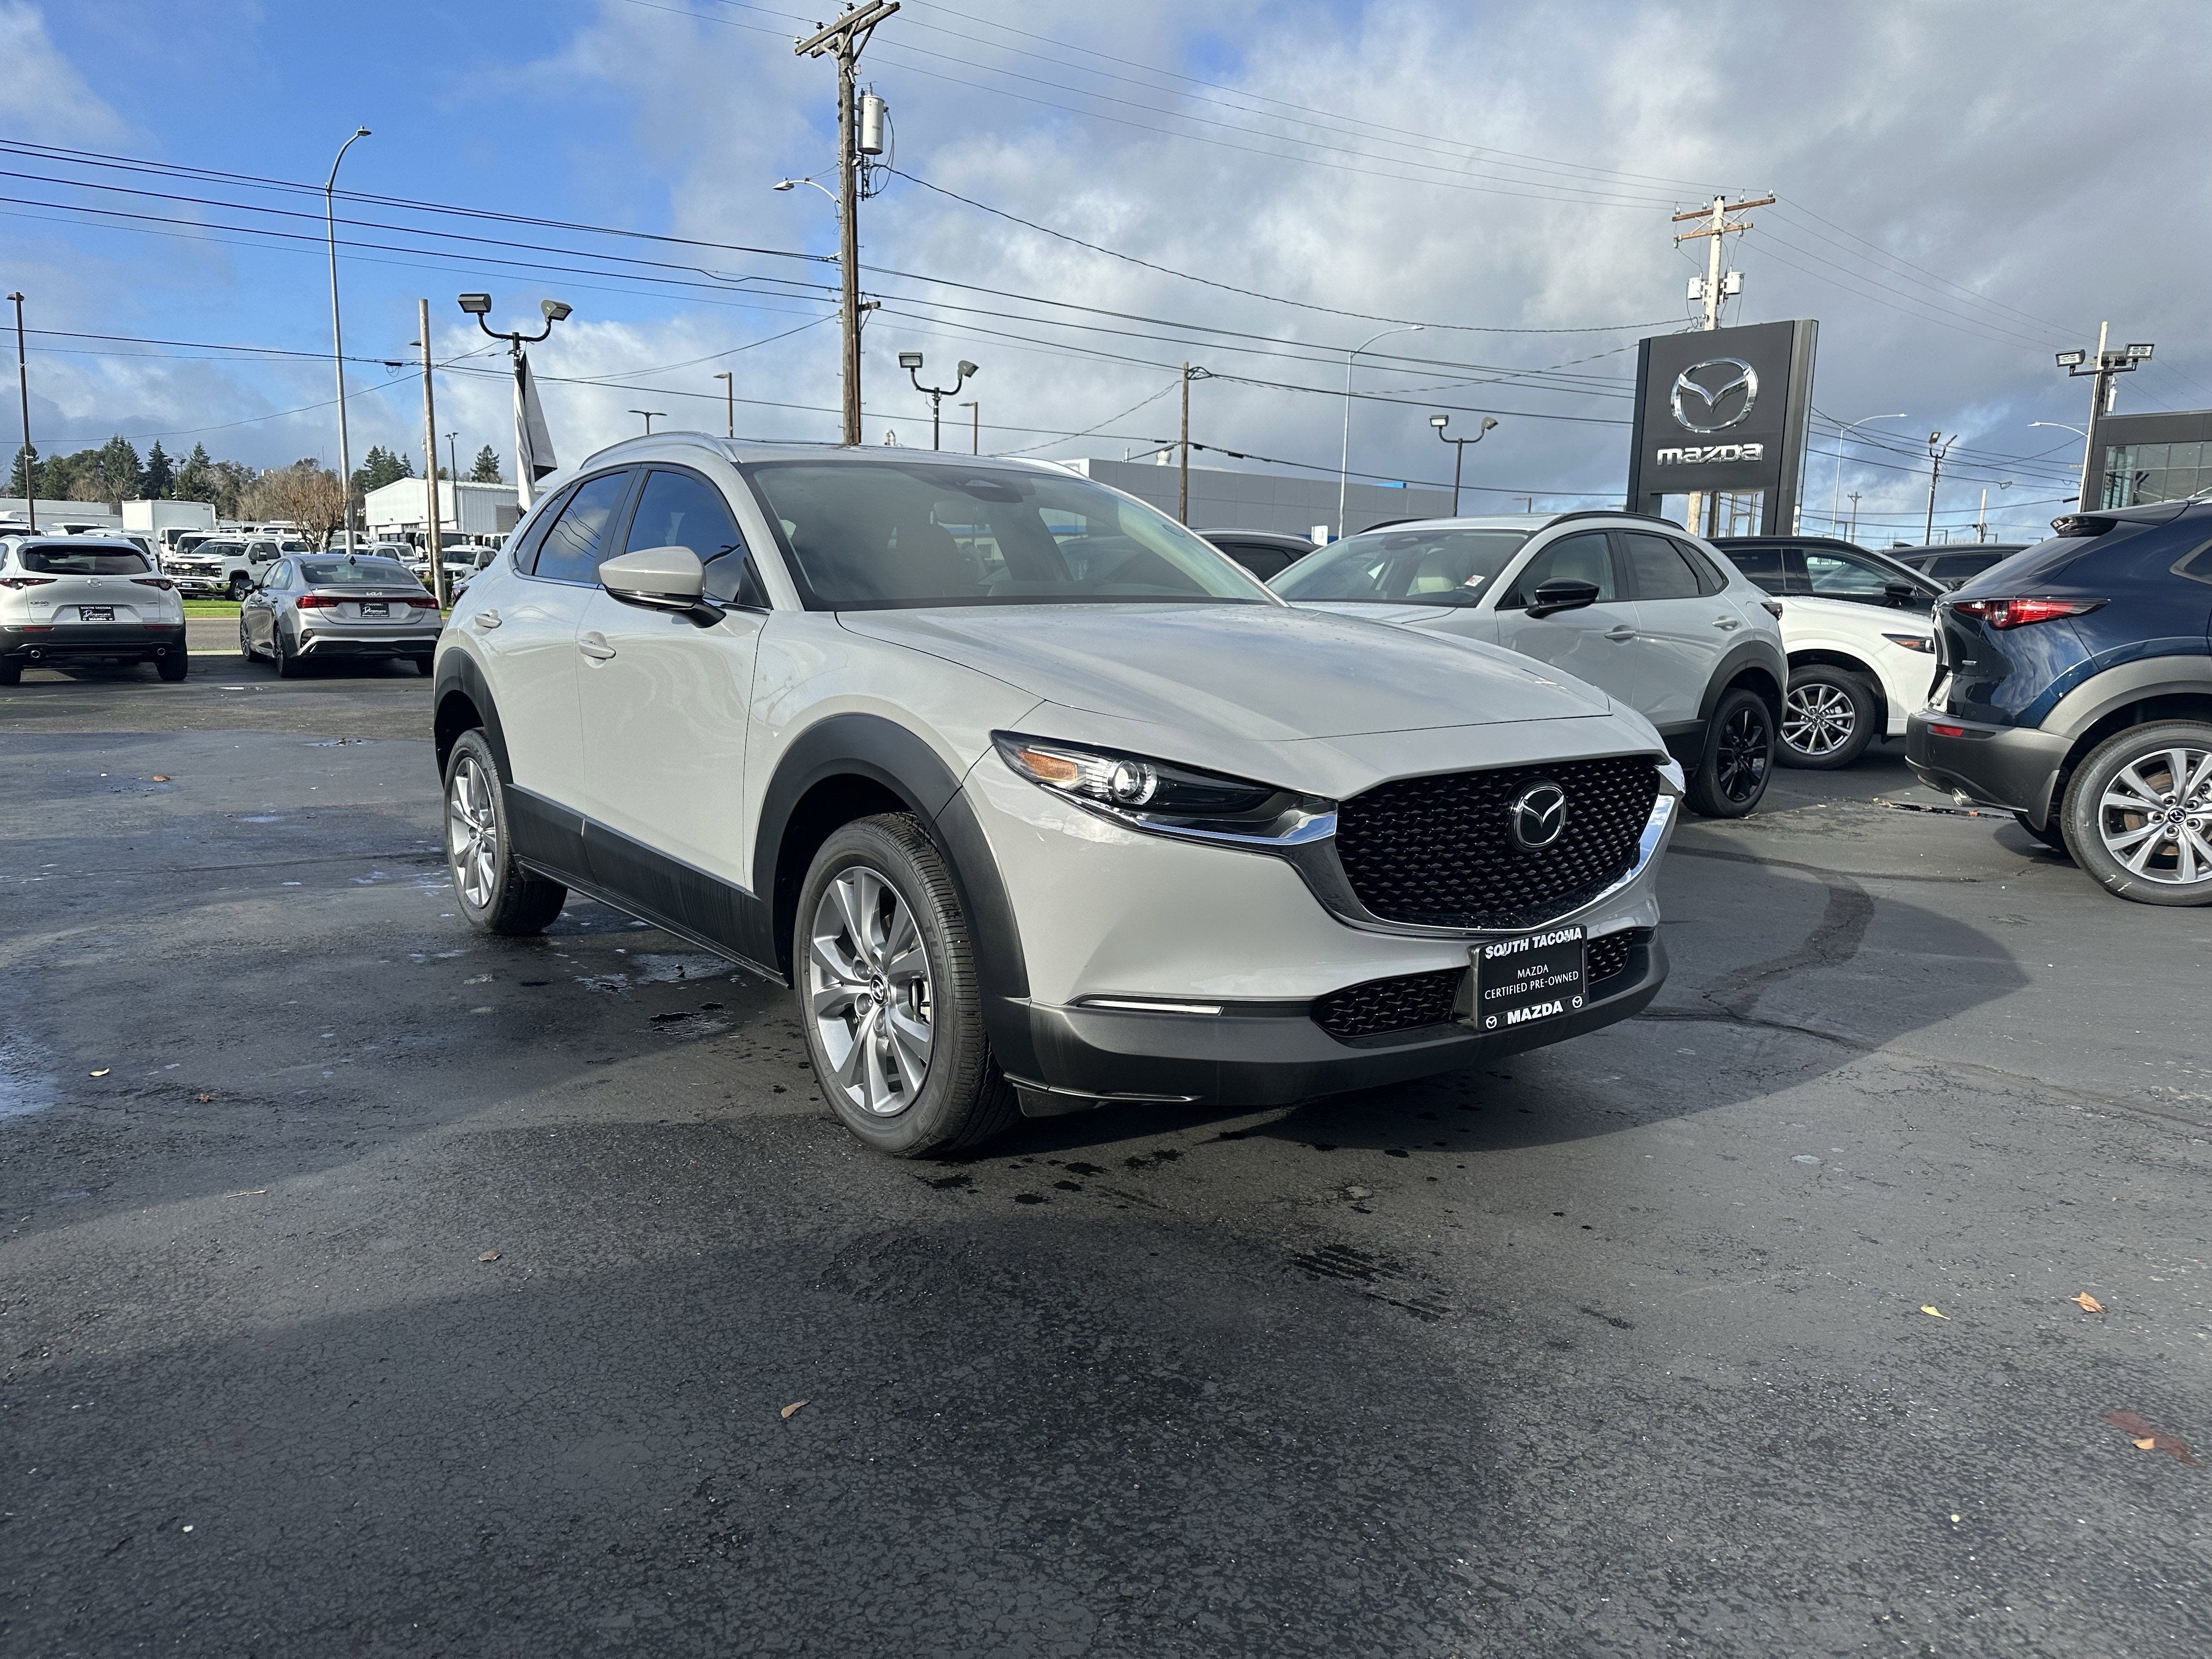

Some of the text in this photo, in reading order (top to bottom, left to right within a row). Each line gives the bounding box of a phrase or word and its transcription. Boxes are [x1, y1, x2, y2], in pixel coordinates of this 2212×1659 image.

[1485, 927, 1582, 960] SOUTH TACOMA
[1484, 970, 1579, 1000] CERTIFIED PRE-OWNED
[1517, 964, 1549, 979] MAZDA
[1507, 1000, 1564, 1025] MAZDA
